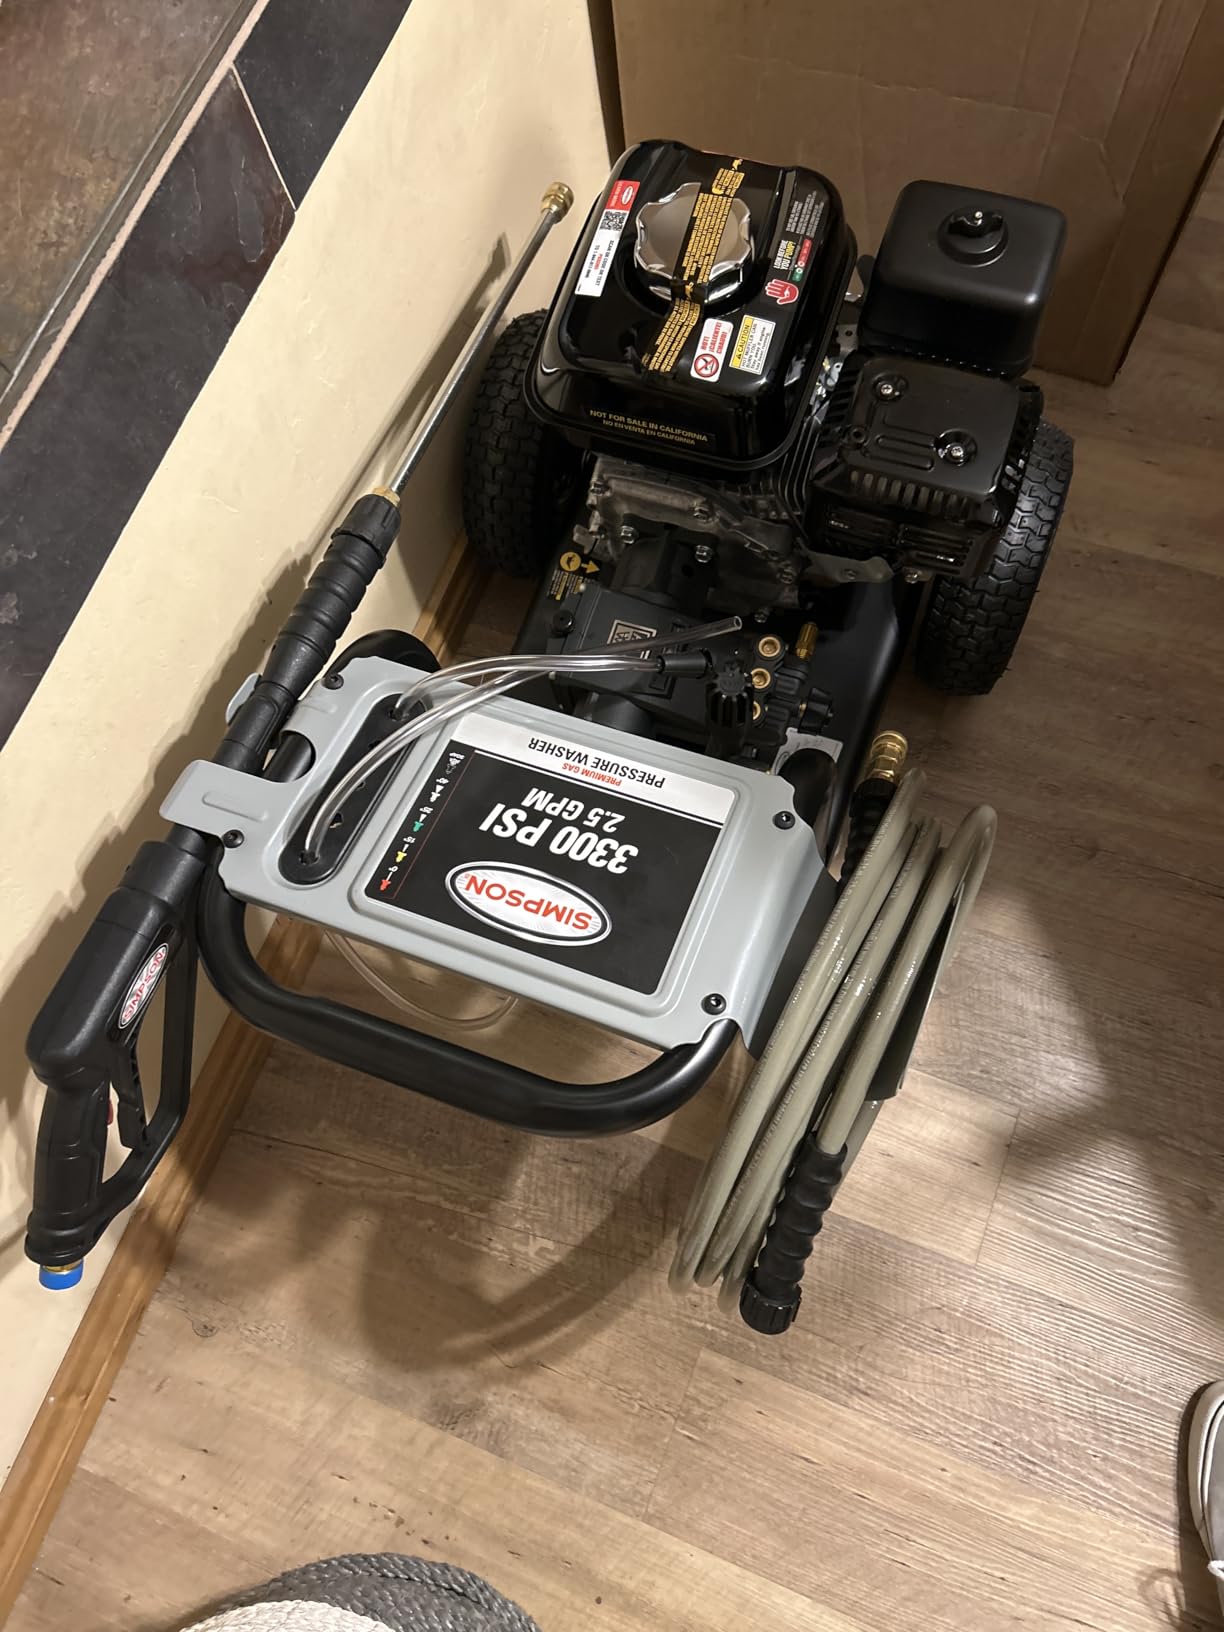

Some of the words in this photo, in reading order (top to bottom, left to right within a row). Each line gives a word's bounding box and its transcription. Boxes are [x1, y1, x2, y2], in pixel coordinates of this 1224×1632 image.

[773, 257, 782, 269] LOOK
[778, 240, 788, 258] BEFORE
[781, 257, 790, 270] YOU
[701, 336, 710, 350] HOT!
[738, 325, 749, 352] CAUTION
[745, 334, 753, 355] MUFFLER
[589, 409, 607, 419] NOT
[608, 413, 626, 423] FOR
[626, 417, 648, 428] SALE
[648, 421, 658, 430] IN
[659, 424, 708, 442] CALIFORNIA
[624, 424, 646, 434] VENTA
[656, 431, 696, 446] CALIFORNIA
[527, 737, 590, 766] WASHER
[561, 762, 581, 774] GAS
[581, 769, 622, 787] PREMIUM
[592, 757, 666, 789] PRESSURE
[520, 787, 584, 821] GPM
[478, 802, 552, 847] PSI
[583, 807, 626, 833] 2.5
[549, 826, 639, 874] 3300
[388, 865, 399, 873] 0°
[465, 874, 593, 930] SIMPSON
[124, 951, 164, 1020] SIMPSON
